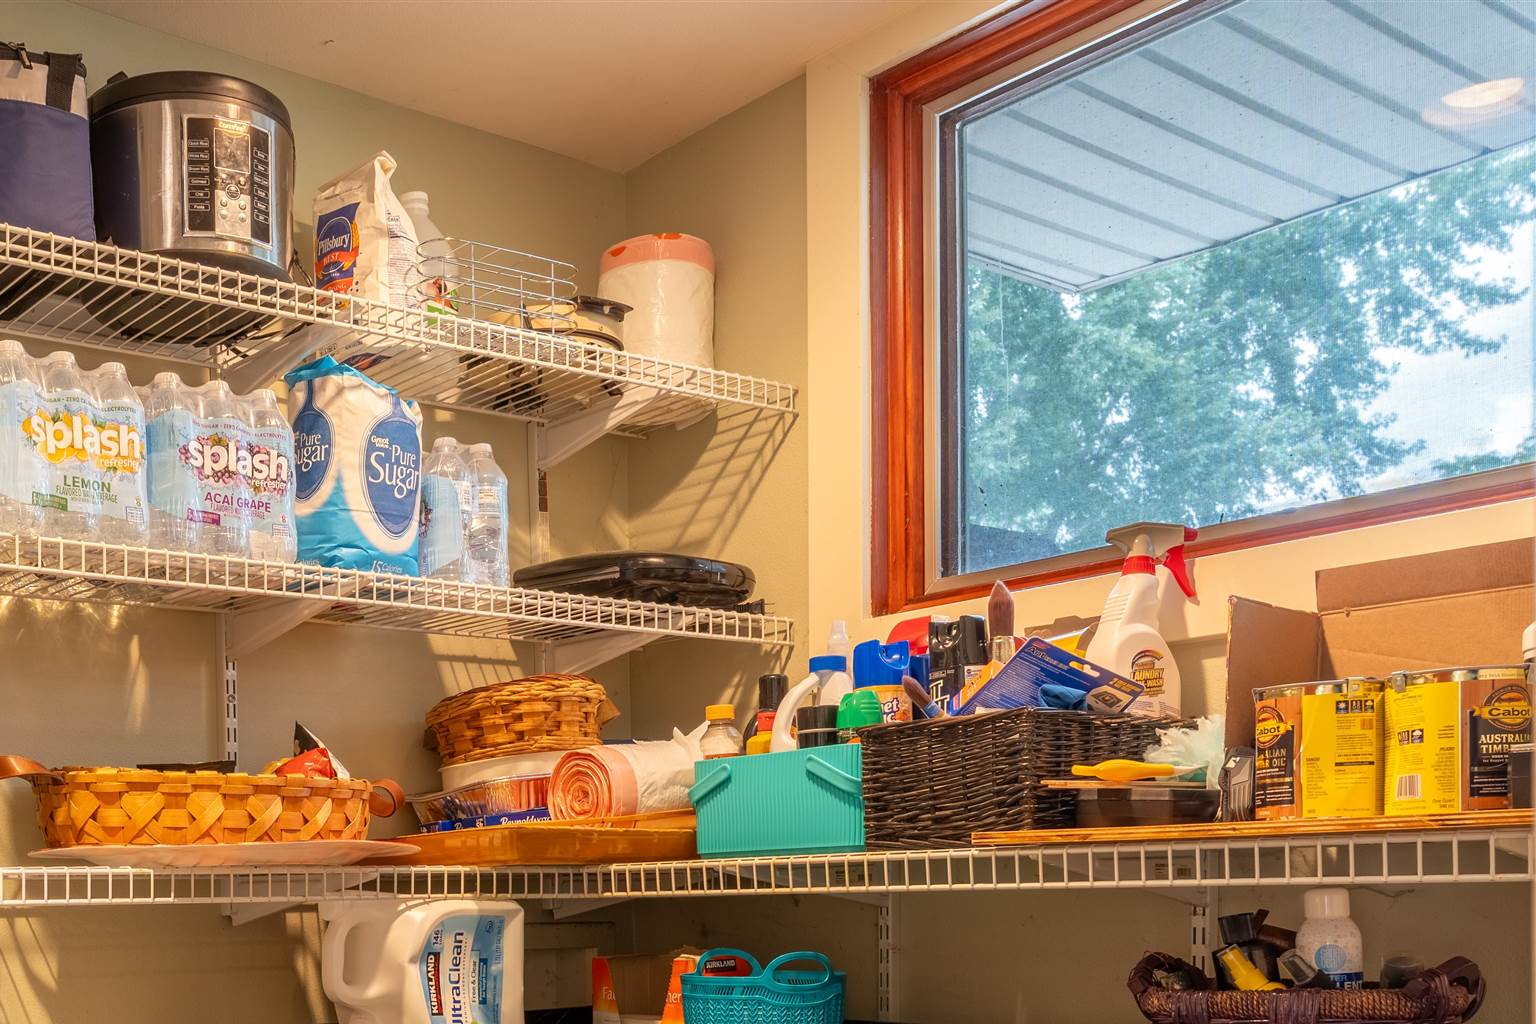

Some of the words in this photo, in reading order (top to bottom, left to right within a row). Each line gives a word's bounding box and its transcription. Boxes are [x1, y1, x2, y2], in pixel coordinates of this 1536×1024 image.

[318, 233, 351, 256] Pillsbury
[30, 415, 141, 459] splash
[300, 432, 321, 446] Pure
[188, 437, 289, 480] splash
[295, 443, 329, 471] ugar
[391, 444, 417, 468] Pure
[63, 474, 112, 493] LEMON
[368, 451, 419, 499] Sugar
[236, 497, 271, 513] GRAPE
[1487, 706, 1531, 717] Cabot
[432, 929, 440, 946] 146
[705, 959, 736, 969] KIRKLAND
[428, 954, 439, 1015] KIRKLAND
